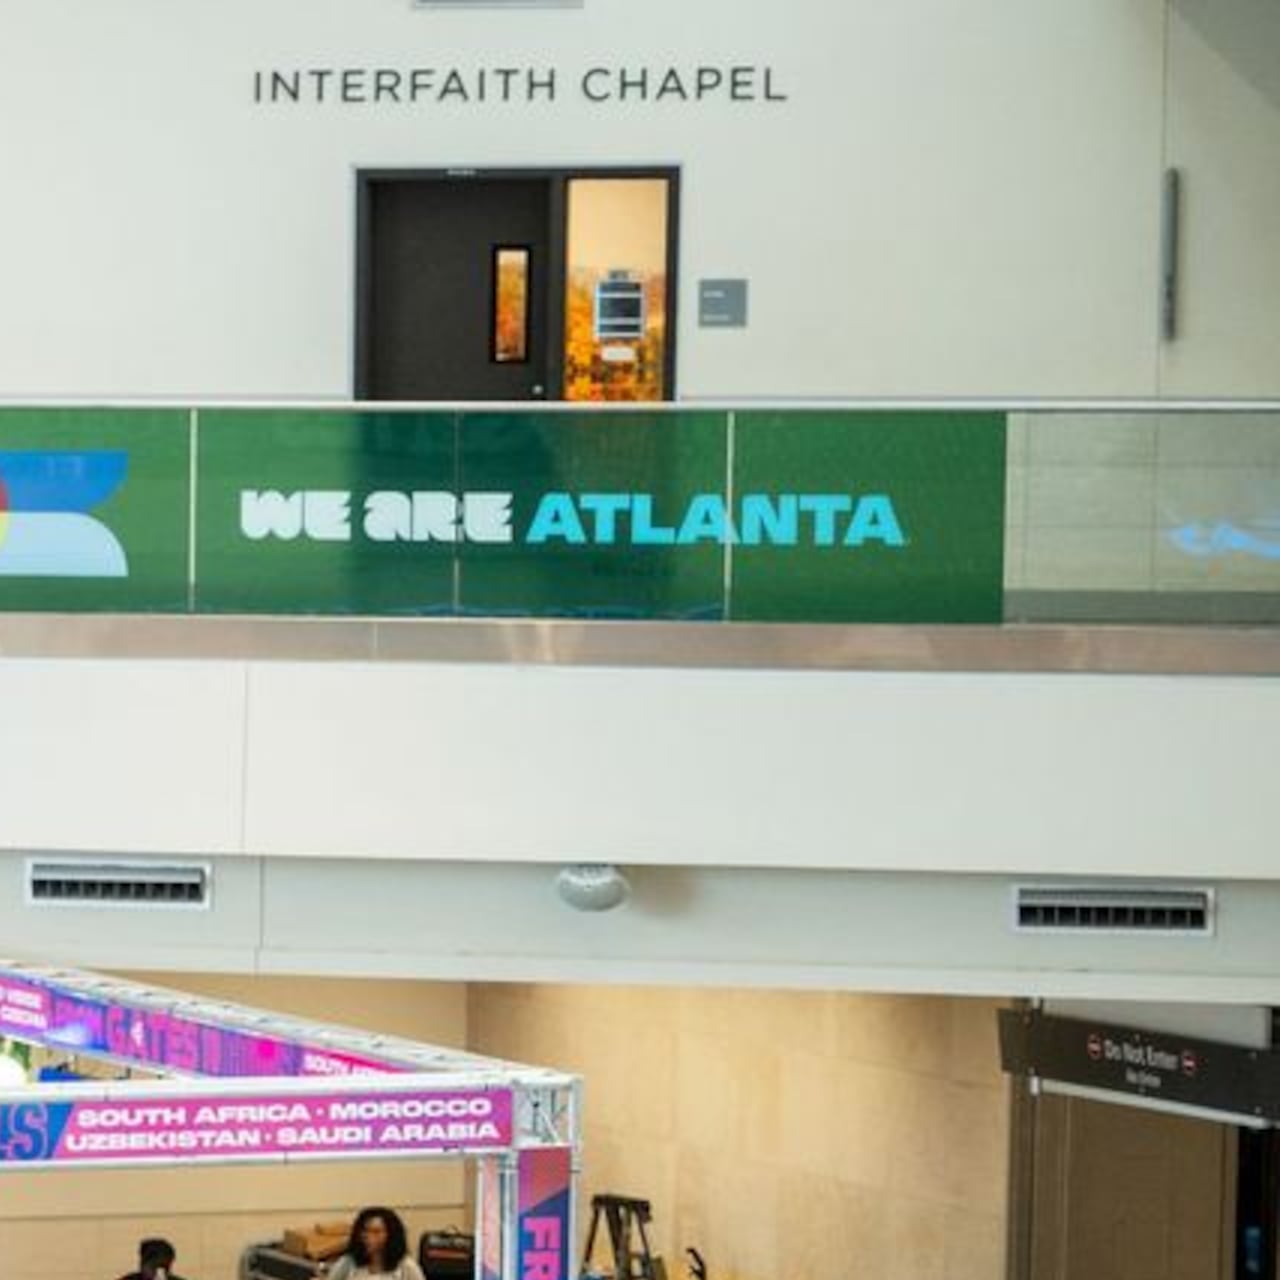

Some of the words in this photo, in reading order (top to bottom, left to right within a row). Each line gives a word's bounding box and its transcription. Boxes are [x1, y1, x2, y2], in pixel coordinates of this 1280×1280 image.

[253, 70, 556, 103] INTERFAITH
[581, 66, 787, 100] CHAPEL
[241, 489, 351, 542] WE
[526, 492, 904, 547] ATLANTA
[77, 1107, 186, 1128] SOUTH
[194, 1103, 312, 1124] AFRICA
[329, 1098, 493, 1120] MOROCCO
[65, 1130, 262, 1152] UZBEKISTAN
[277, 1126, 372, 1147] SAUDI
[379, 1121, 500, 1144] ARABIA
